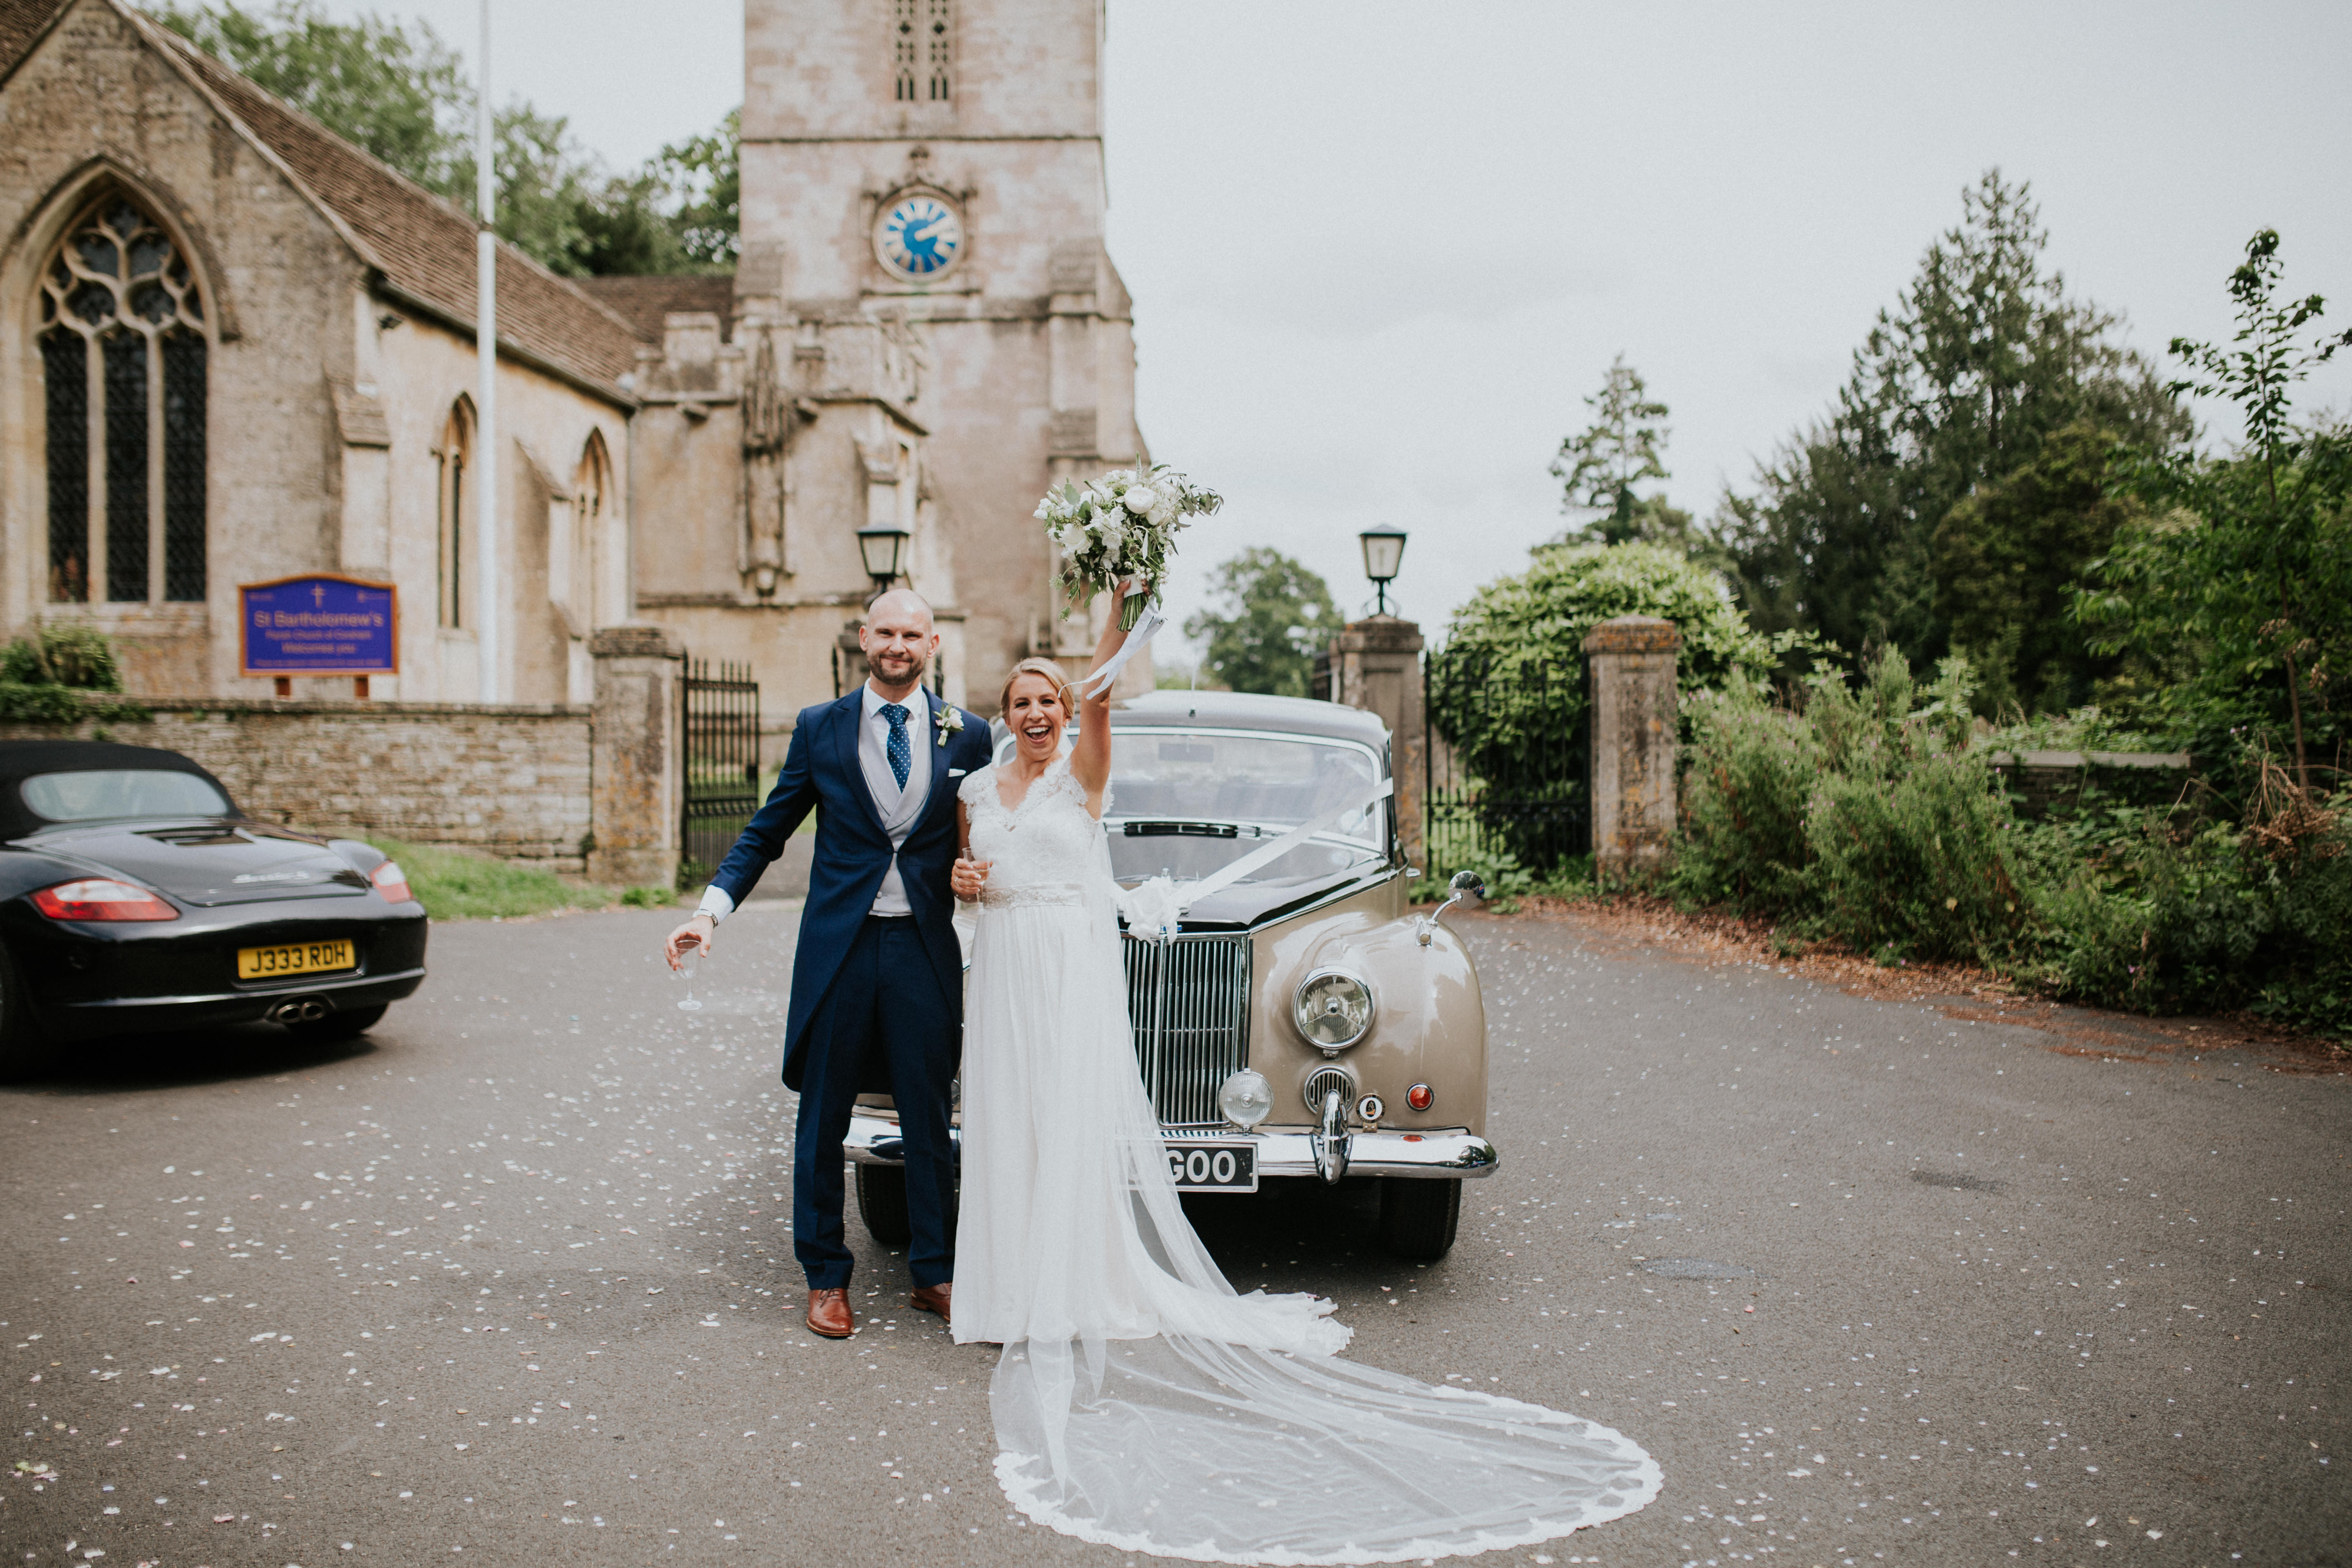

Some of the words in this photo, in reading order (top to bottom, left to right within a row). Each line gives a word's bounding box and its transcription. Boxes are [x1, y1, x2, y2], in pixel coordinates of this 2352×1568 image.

[254, 611, 272, 627] St
[274, 611, 383, 627] Bartholomew's
[250, 949, 302, 972] J333
[310, 942, 346, 966] RDH
